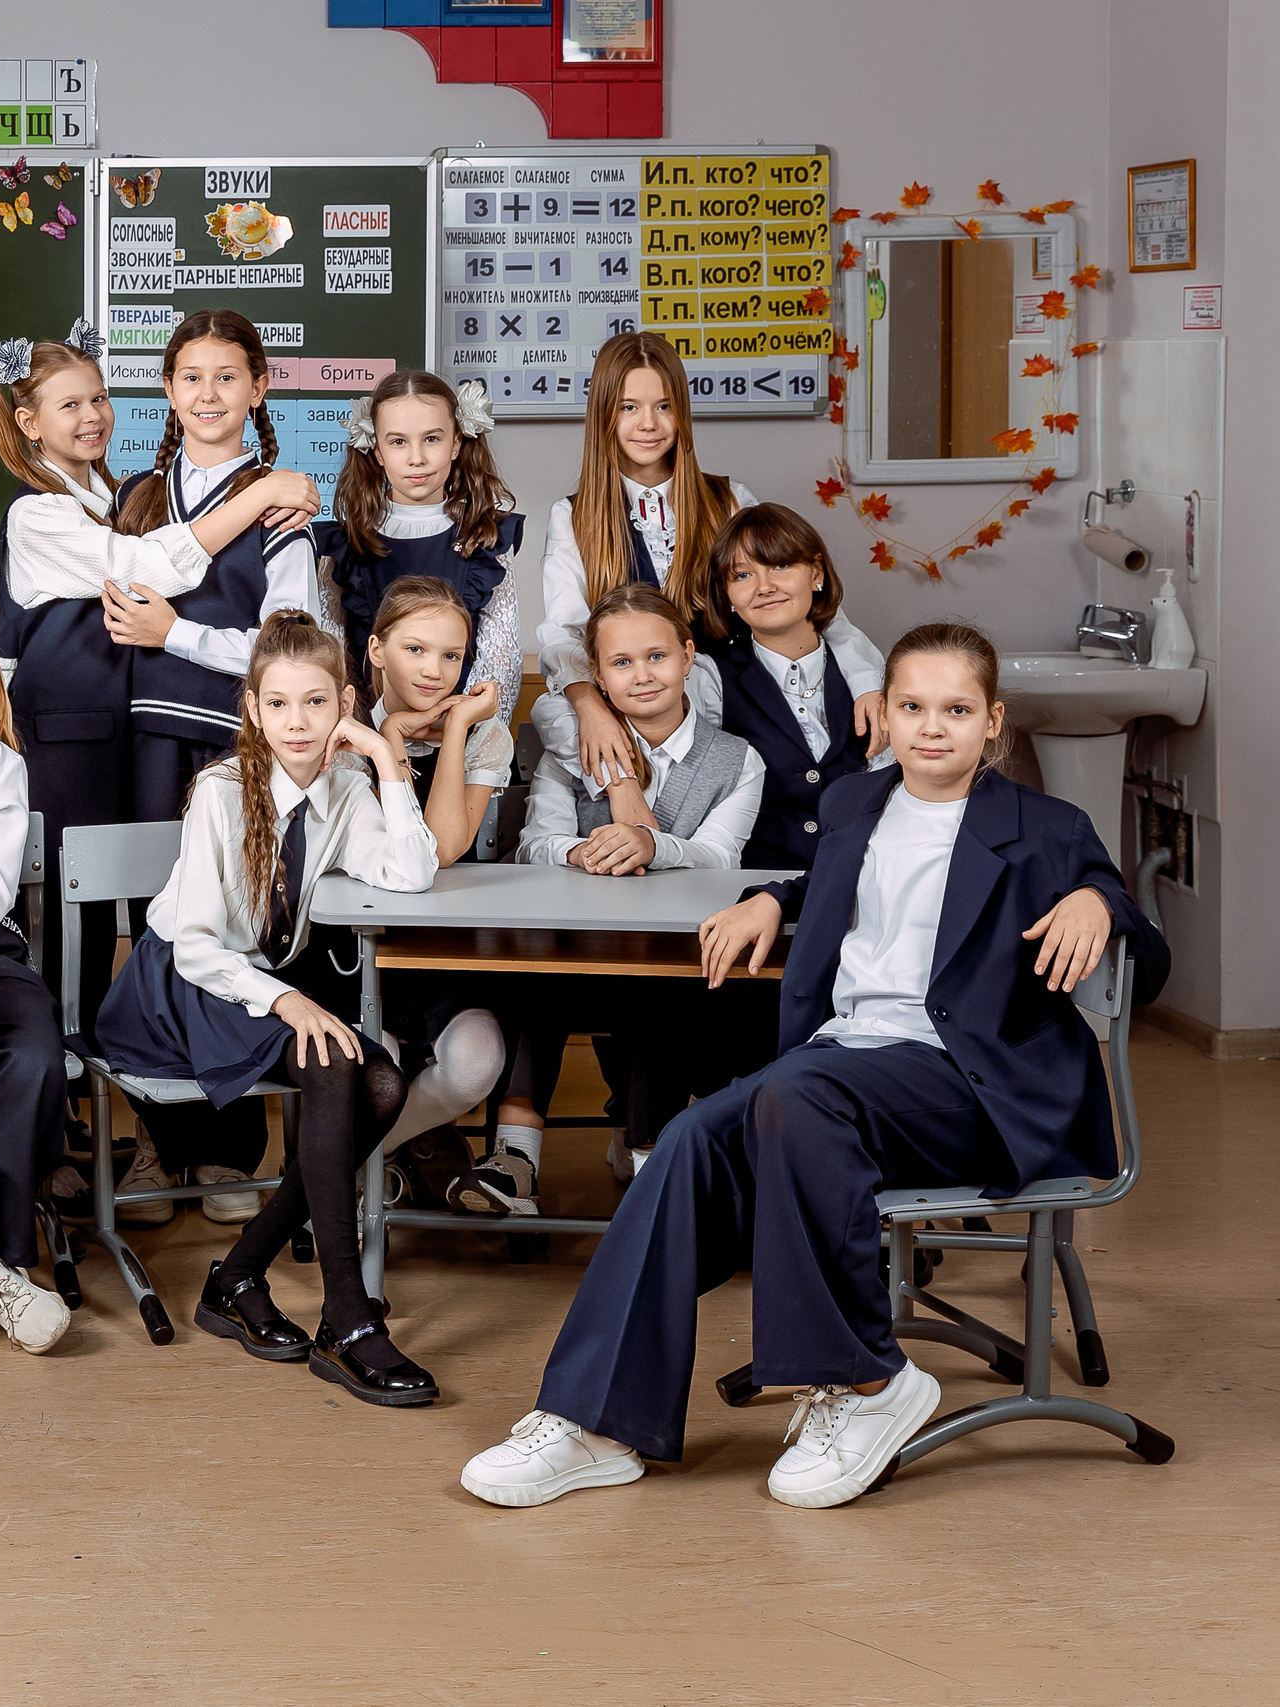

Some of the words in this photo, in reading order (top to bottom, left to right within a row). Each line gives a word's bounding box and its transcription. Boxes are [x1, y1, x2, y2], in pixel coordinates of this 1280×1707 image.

[60, 69, 81, 93] Ъ
[26, 113, 54, 143] Щ
[62, 113, 80, 137] Ь
[449, 171, 504, 184] СЛАГАЕМОЕ
[515, 170, 570, 184] СЛАГАЕМОЕ
[590, 169, 625, 183] СУММА
[706, 161, 757, 184] кто?
[770, 160, 822, 183] что?
[206, 171, 269, 194] ЗВУКИ
[473, 199, 489, 217] 3
[609, 198, 636, 217] 12
[699, 194, 760, 217] кого?
[765, 193, 826, 216] чего?
[325, 211, 388, 230] ГЛАСНЫЕ
[445, 232, 506, 245] УМЕНЬШАЕМОЕ
[514, 231, 575, 245] ВЫЧИТАЕМОЕ
[586, 232, 633, 245] РАЗНОСТЬ
[701, 225, 761, 251] кому?
[766, 223, 828, 250] чему?
[111, 252, 172, 268] ЗВОНКИЕ
[326, 249, 389, 268] БЕЗУДАРНЫЕ
[467, 258, 494, 277] 15
[549, 258, 561, 276] 1
[601, 257, 628, 277] 14
[111, 275, 172, 290] ГЛУХИЕ
[175, 269, 237, 285] ПАРНЫЕ
[239, 267, 302, 284] НЕПАРНЫЕ
[701, 260, 761, 284] кого?
[773, 259, 825, 282] что?
[328, 272, 390, 292] УДАРНЫЕ
[444, 290, 505, 304] МНОЖИТЕЛЬ
[511, 289, 571, 303] МНОЖИТЕЛЬ
[578, 289, 639, 304] ПРОИЗВЕДЕНИЕ
[704, 295, 762, 319] кем?
[768, 300, 823, 317] чем
[110, 310, 171, 325] ТВЕРДЫЕ
[463, 317, 479, 336] 8
[546, 317, 562, 336] 2
[609, 319, 635, 333] 16
[110, 329, 171, 346] МЯГКИЕ
[784, 328, 832, 349] чём?
[453, 351, 497, 365] ДЕЛИМОЕ
[523, 350, 567, 365] ДЕЛИТЕЛЬ
[110, 365, 163, 380] Исключ
[320, 364, 375, 383] брить
[532, 376, 548, 395] 4
[689, 377, 714, 395] 10
[720, 376, 747, 395] 18
[788, 376, 816, 395] 19
[131, 407, 168, 420] гнат
[120, 439, 160, 453] дыш
